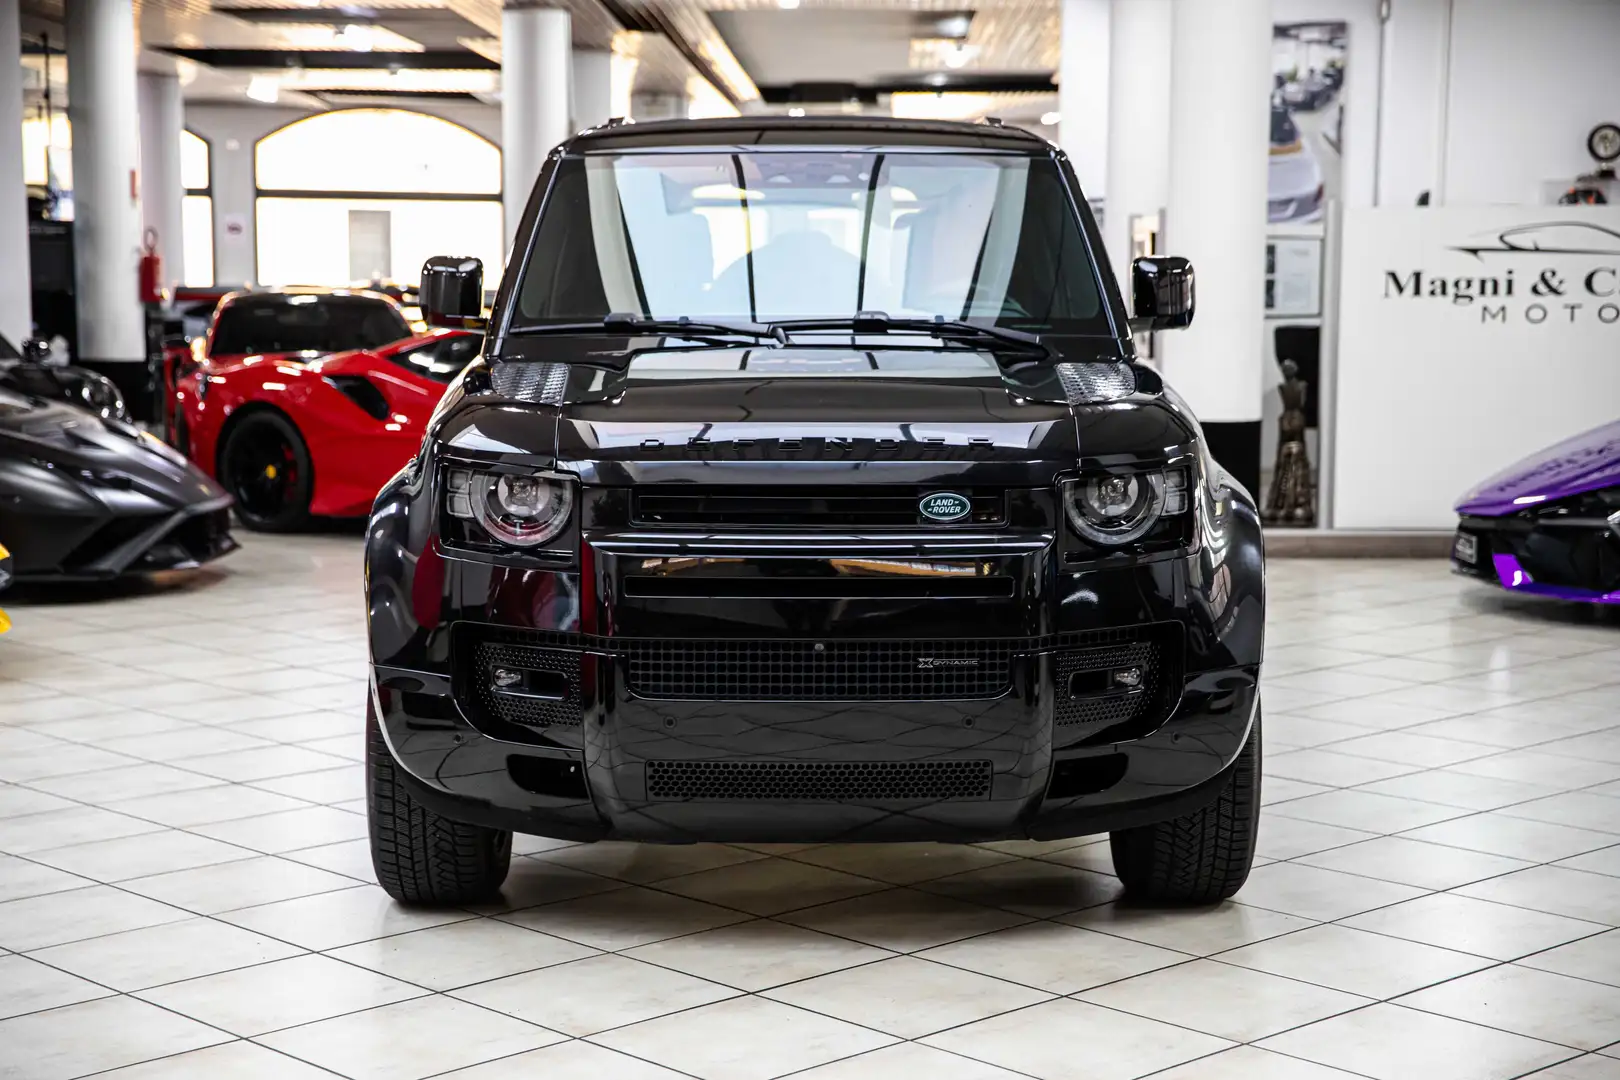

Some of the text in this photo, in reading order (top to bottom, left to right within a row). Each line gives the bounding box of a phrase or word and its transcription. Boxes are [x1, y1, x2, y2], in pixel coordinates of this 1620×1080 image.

[1383, 266, 1620, 305] Magni & C
[640, 437, 995, 451] DEFENDER
[932, 506, 961, 514] ROVER
